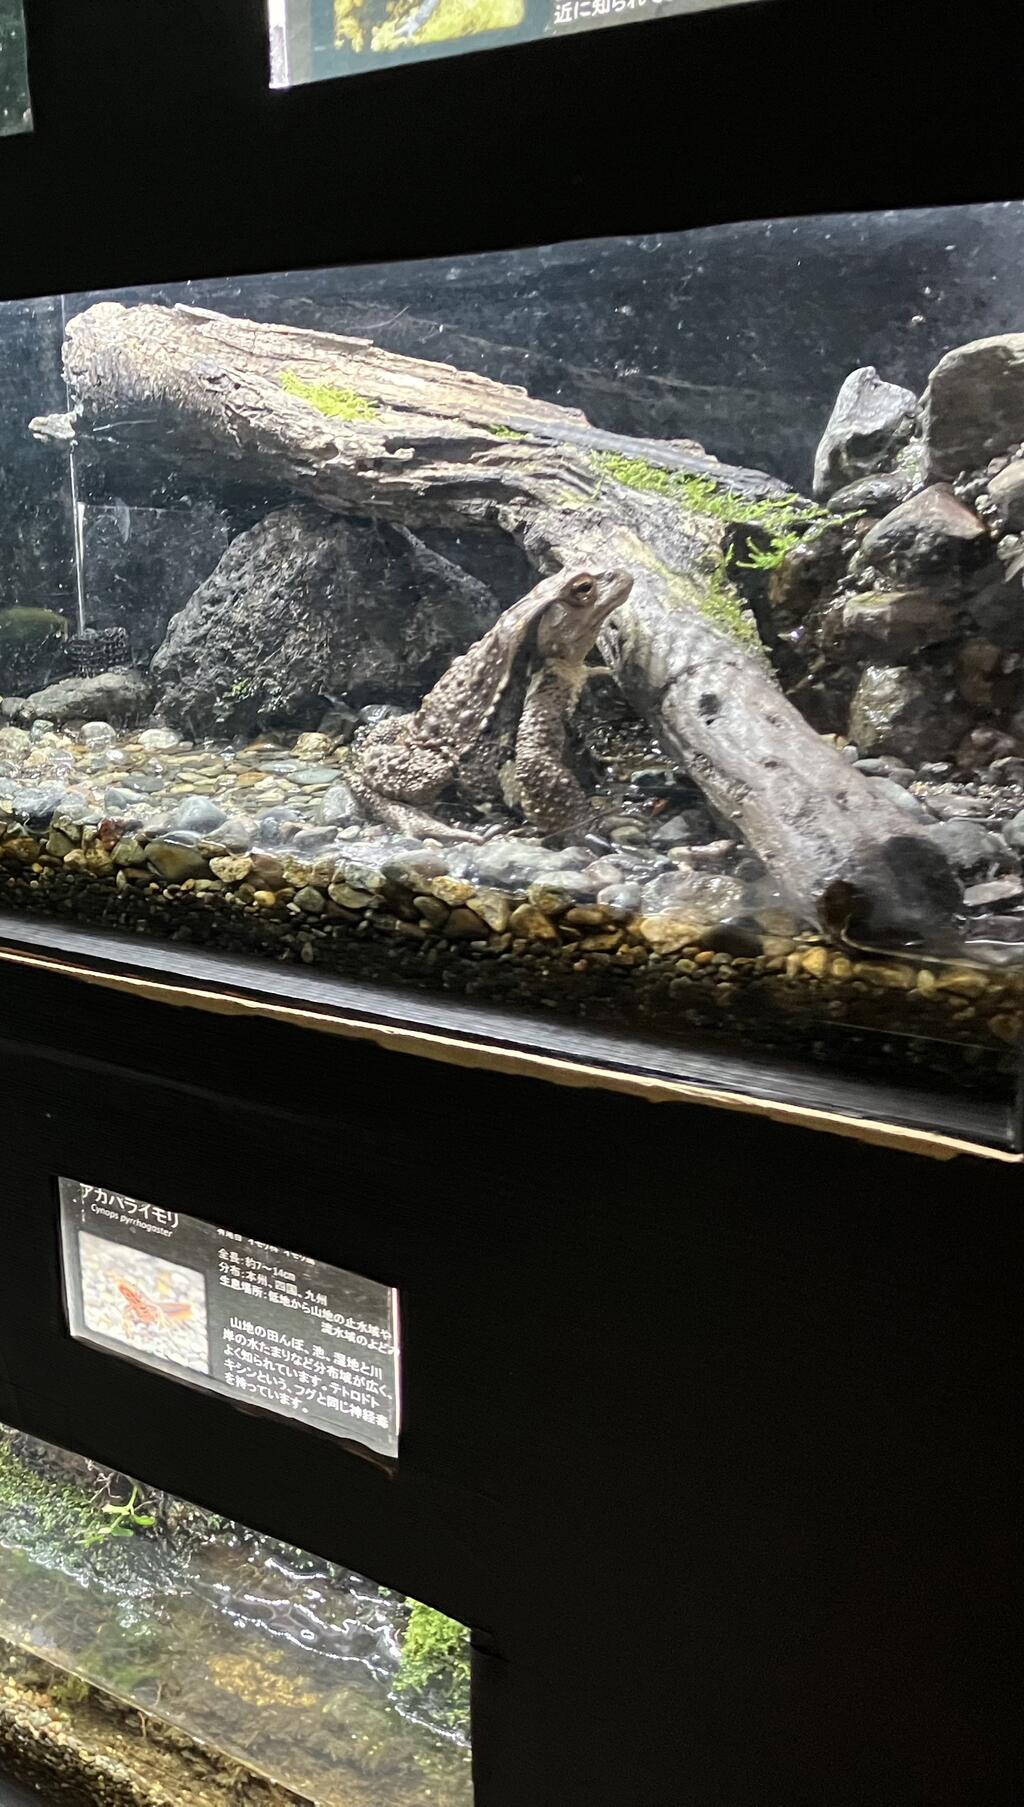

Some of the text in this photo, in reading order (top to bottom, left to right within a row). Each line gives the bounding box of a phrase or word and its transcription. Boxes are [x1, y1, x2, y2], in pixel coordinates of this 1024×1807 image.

[91, 1202, 172, 1239] Cynops pyrrhogaster
[223, 1328, 391, 1398] 岸の水たまりなど分布域が広く、
[224, 1343, 379, 1410] よく知られています。テトロドト
[230, 1315, 381, 1379] 山地の田んぼ、池、湿地と川
[224, 1357, 388, 1429] キシンという、フグと同じ神経毒
[225, 1371, 308, 1413] を持っています。
